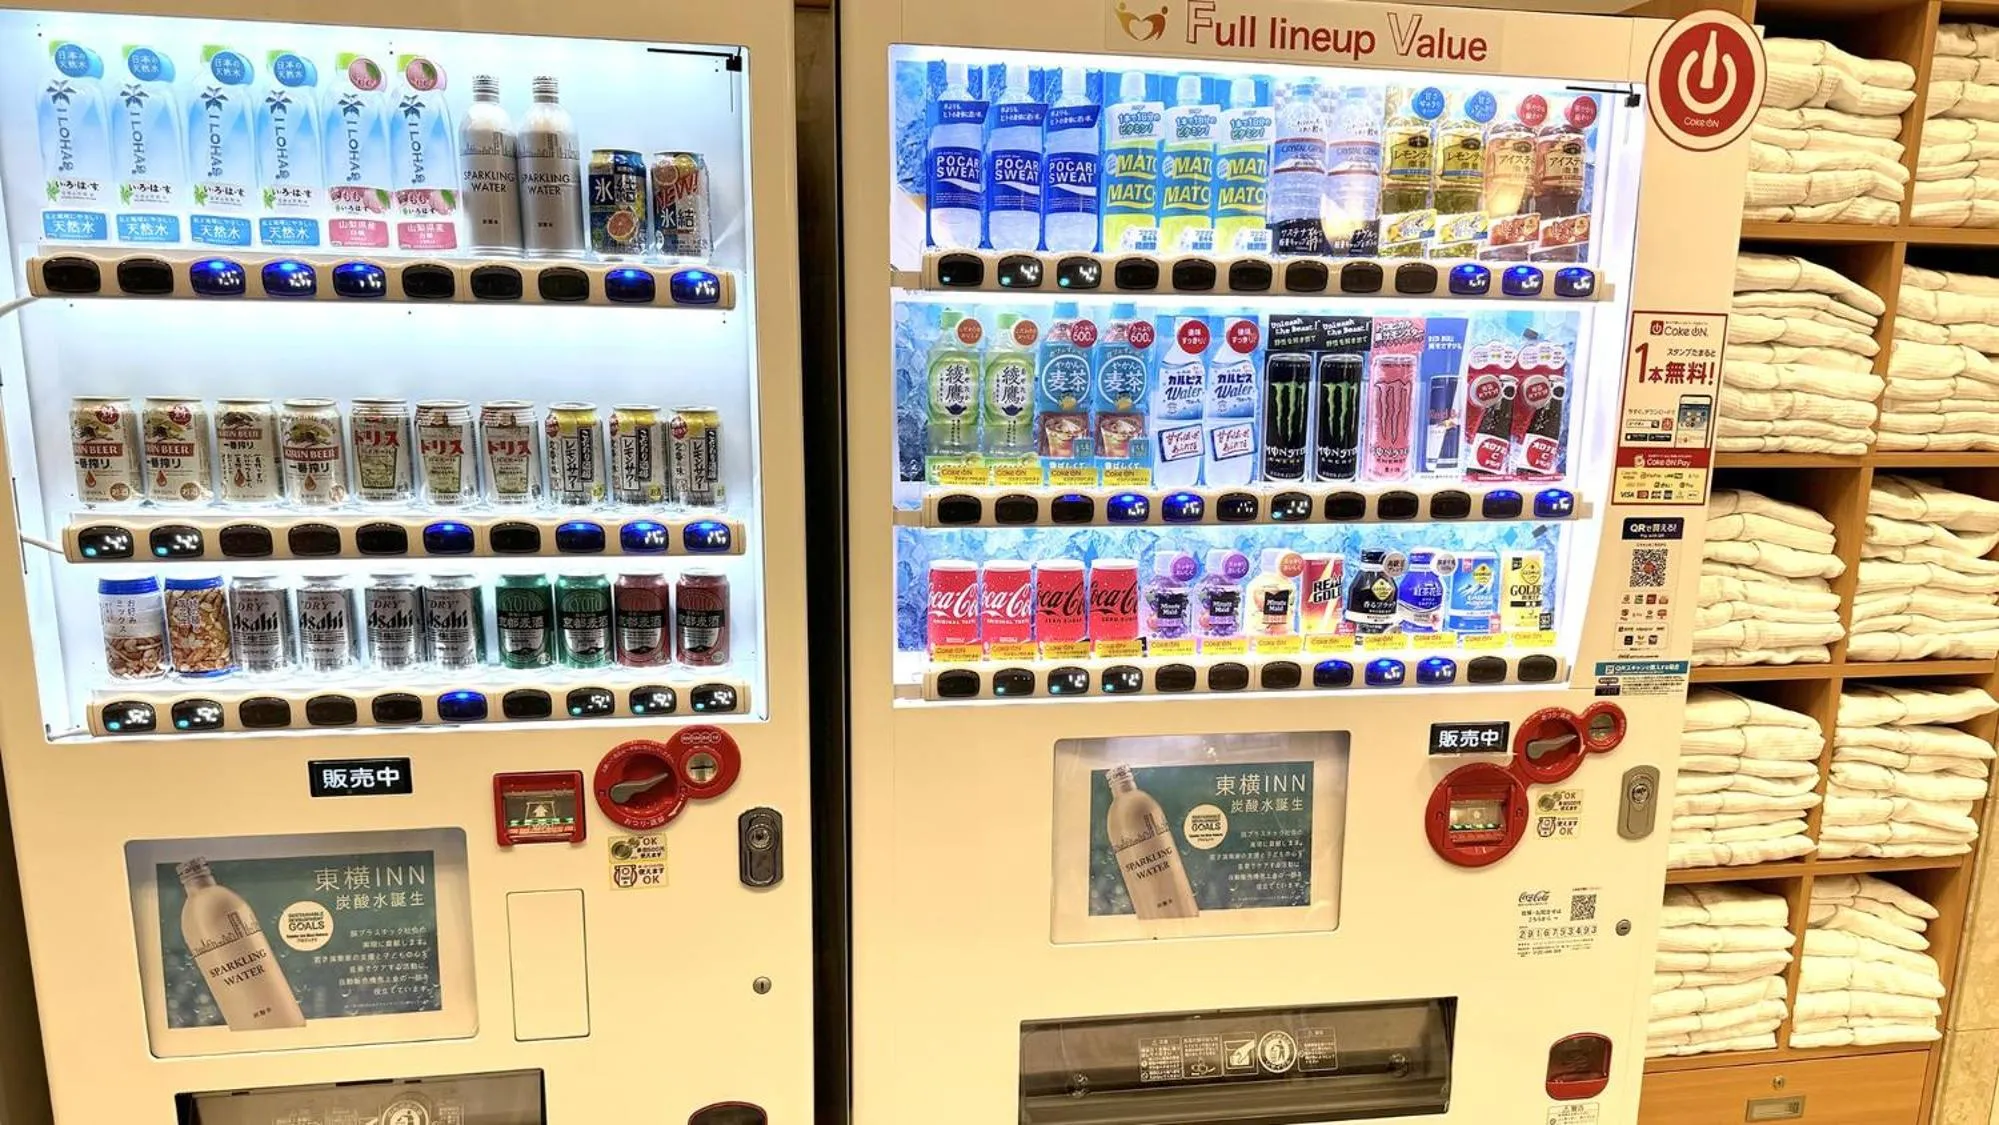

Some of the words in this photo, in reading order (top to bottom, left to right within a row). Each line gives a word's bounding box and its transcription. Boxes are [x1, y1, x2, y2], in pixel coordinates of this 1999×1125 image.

[1186, 0, 1256, 47] Full
[1269, 17, 1376, 60] lineup
[1387, 12, 1488, 62] Value
[936, 167, 980, 179] SWEAT
[1049, 161, 1096, 173] POCARI
[464, 170, 517, 182] SPARKLING
[521, 173, 570, 183] SPARKLING
[995, 170, 1039, 182] SWEAT
[1049, 172, 1094, 184] SWEAT
[472, 183, 507, 193] WATER
[528, 185, 561, 195] WATER
[595, 174, 636, 202] 氷結
[661, 208, 694, 229] 氷結
[1664, 326, 1690, 336] Coke
[1667, 348, 1717, 358] スタンプたまると
[1634, 342, 1715, 386] 1本無料!
[946, 365, 965, 403] 綾鷹
[1002, 365, 1022, 404] 綾鷹
[1048, 370, 1087, 392] 麦茶
[1104, 370, 1143, 392] 麦茶
[1168, 375, 1202, 385] カルピス
[1218, 374, 1253, 384] カルピス
[1165, 386, 1204, 400] Water
[1215, 385, 1254, 399] Water
[354, 429, 400, 447] トリス
[90, 445, 118, 454] BEER
[160, 444, 189, 454] BEER
[310, 448, 336, 459] BEER
[420, 439, 464, 455] トリス
[487, 440, 532, 456] トリス
[565, 440, 578, 490] レモンサワー
[623, 439, 636, 489] レモンサワー
[692, 442, 705, 489] レモンサワー
[1646, 458, 1664, 466] Coke
[117, 600, 127, 633] ミックス
[128, 600, 136, 624] お好み
[300, 609, 344, 631] Asahi
[367, 609, 413, 631] Asahi
[233, 610, 278, 632] Asahi
[1439, 728, 1499, 747] 販売中
[322, 766, 400, 788] 販売中
[1215, 773, 1306, 796] 東横INN
[1231, 796, 1304, 813] 炭酸水誕生
[1559, 827, 1573, 836] OK
[643, 837, 657, 846] OK
[1125, 846, 1173, 872] SPARKLING
[314, 864, 425, 891] 東横INN
[1136, 861, 1170, 879] WATER
[643, 875, 660, 885] OK
[336, 891, 425, 911] 炭酸水誕生
[1518, 890, 1551, 903] Coca-Cola
[288, 921, 325, 931] GOALS
[209, 948, 267, 978] SPARKLING
[223, 964, 265, 987] WATER
